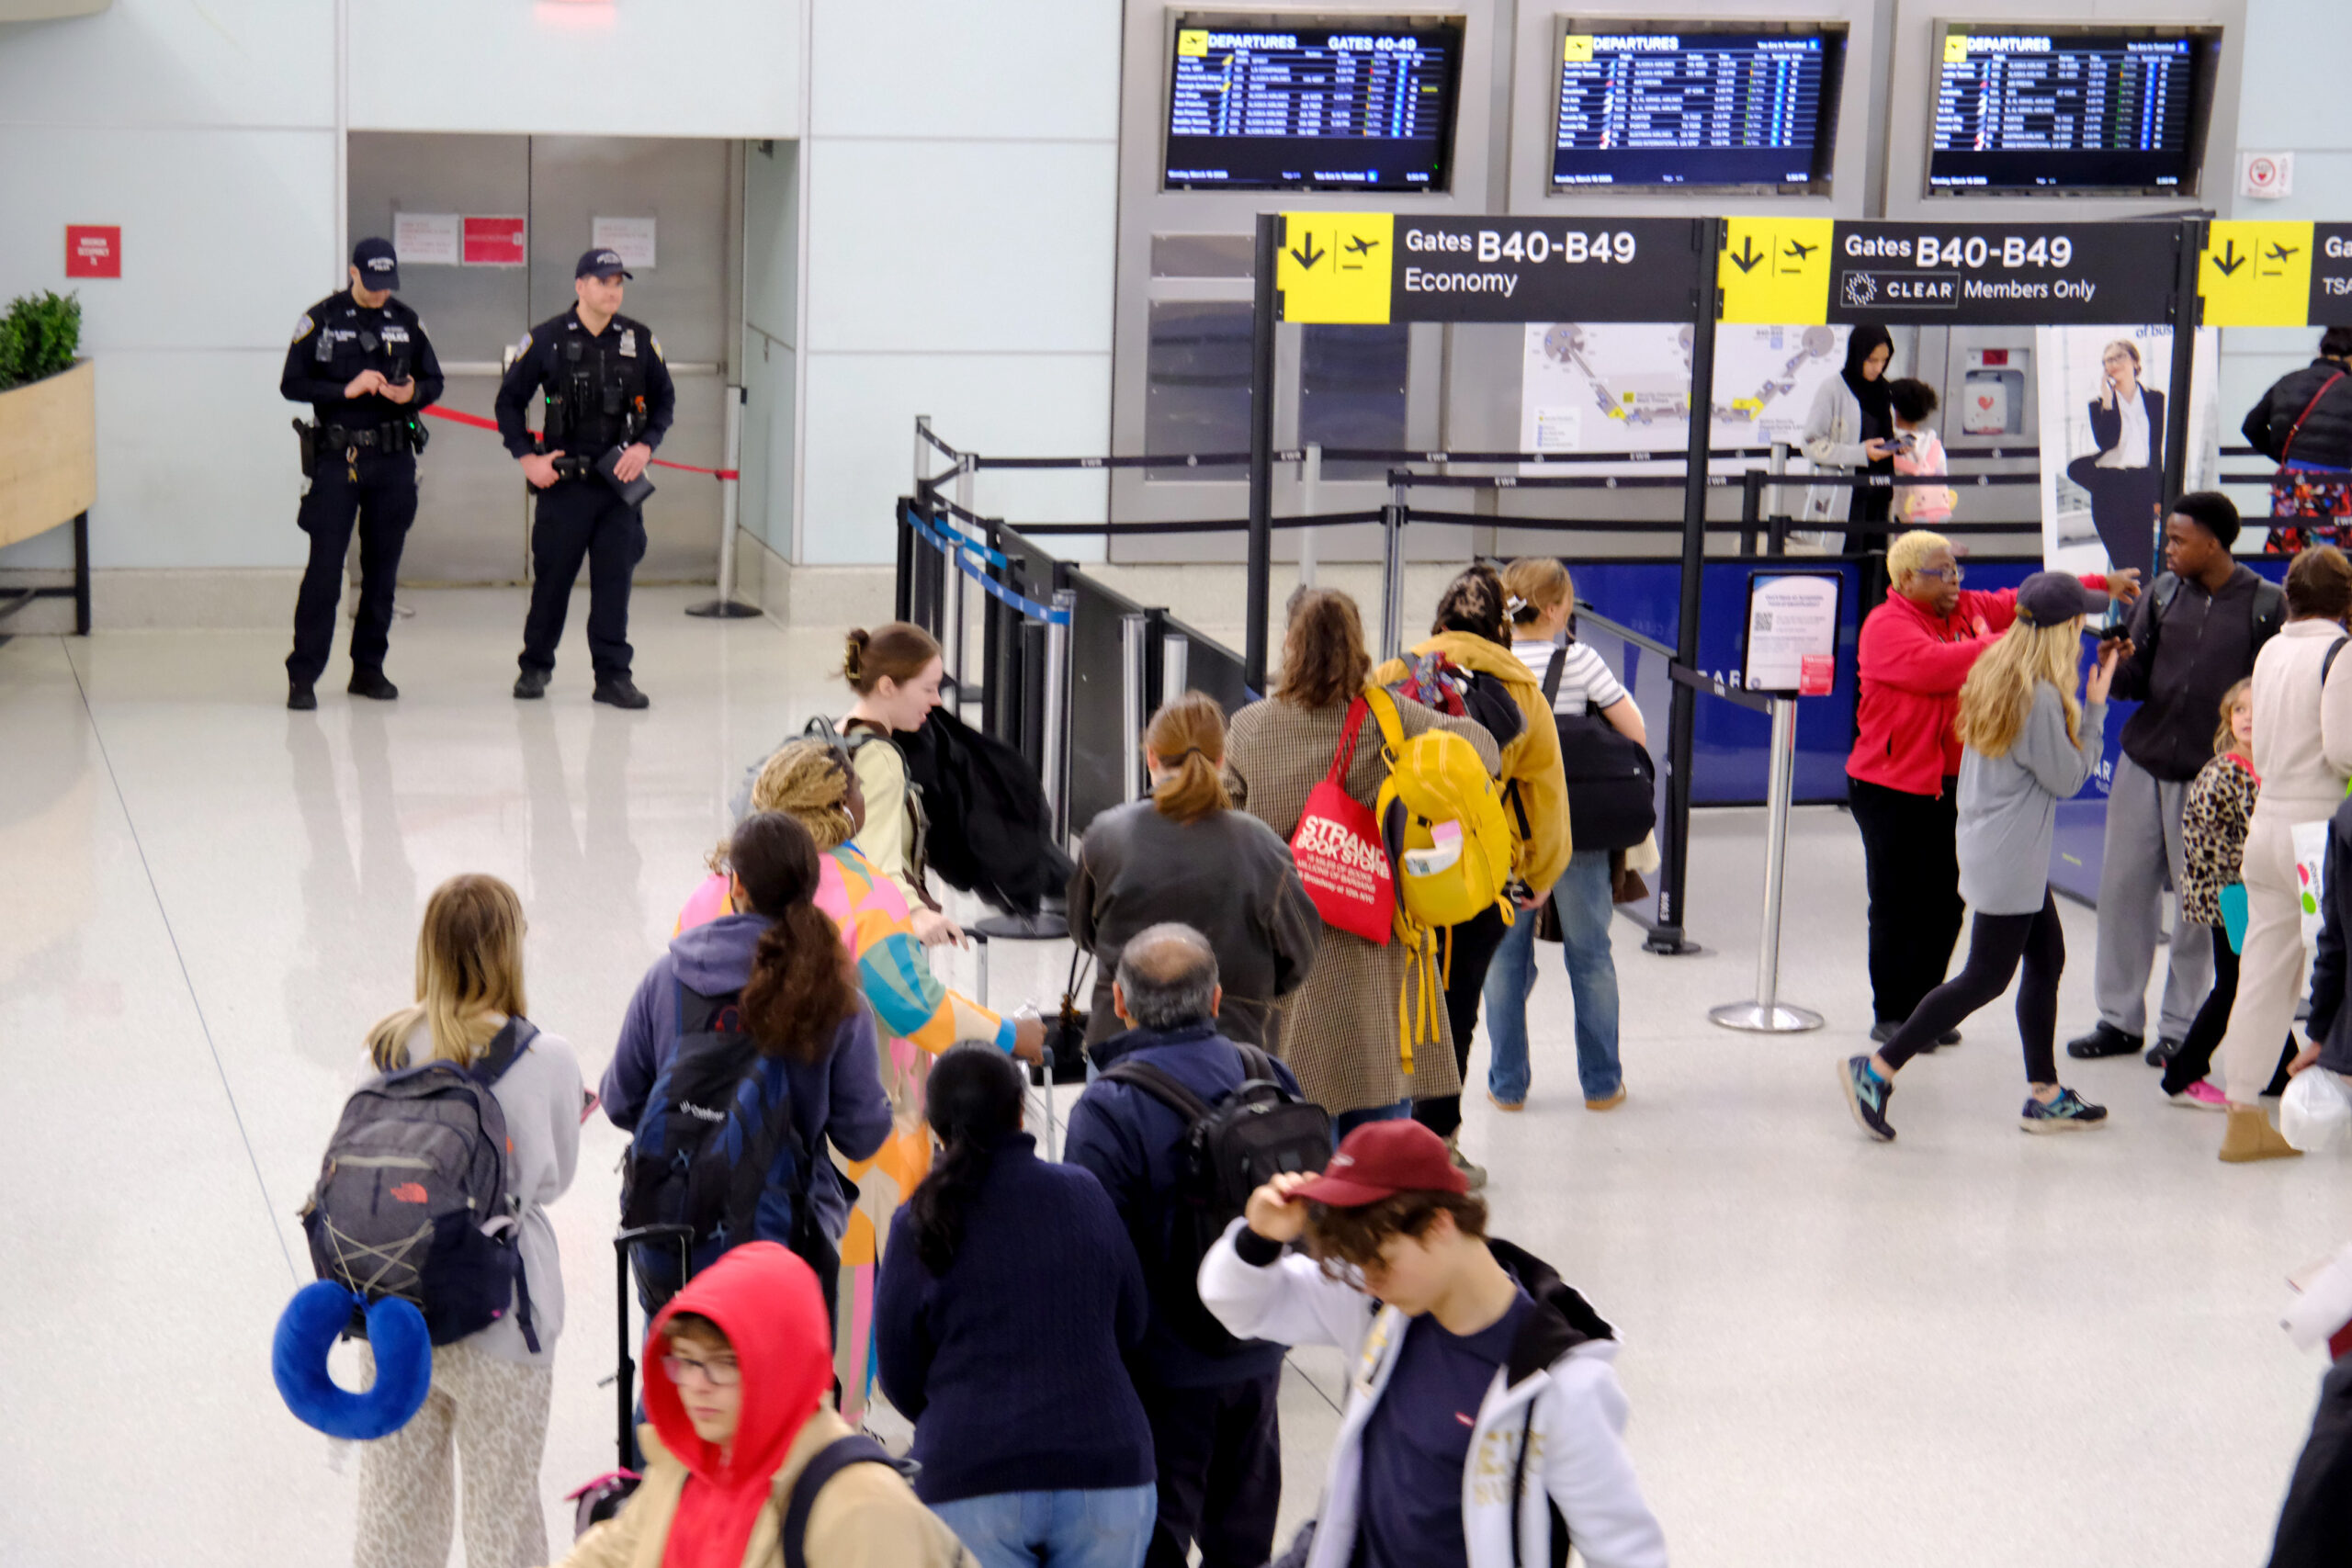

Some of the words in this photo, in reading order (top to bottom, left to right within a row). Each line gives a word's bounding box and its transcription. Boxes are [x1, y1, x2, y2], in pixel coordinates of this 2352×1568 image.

[1208, 34, 1297, 49] DEPARTURES
[1328, 36, 1374, 51] GATES
[1374, 37, 1417, 51] 40-49
[1593, 37, 1679, 51] DEPARTURES
[1967, 37, 2051, 51] DEPARTURES
[1407, 230, 1472, 252] Gates
[1478, 231, 1636, 264] B40-B49
[1846, 234, 1911, 257] Gates
[1917, 236, 2072, 268] B40-B49
[1406, 267, 1518, 298] Economy
[1887, 281, 1952, 299] CLEAR
[1963, 279, 2048, 299] Members
[2053, 278, 2096, 302] Only
[1281, 451, 1302, 461] EWR
[1427, 452, 1448, 462] EWR
[1630, 452, 1651, 461] EWR
[1495, 477, 1516, 487] EWR
[1869, 476, 1891, 486] EWR
[1296, 829, 1341, 861] BOOK
[1340, 847, 1390, 880] STORE
